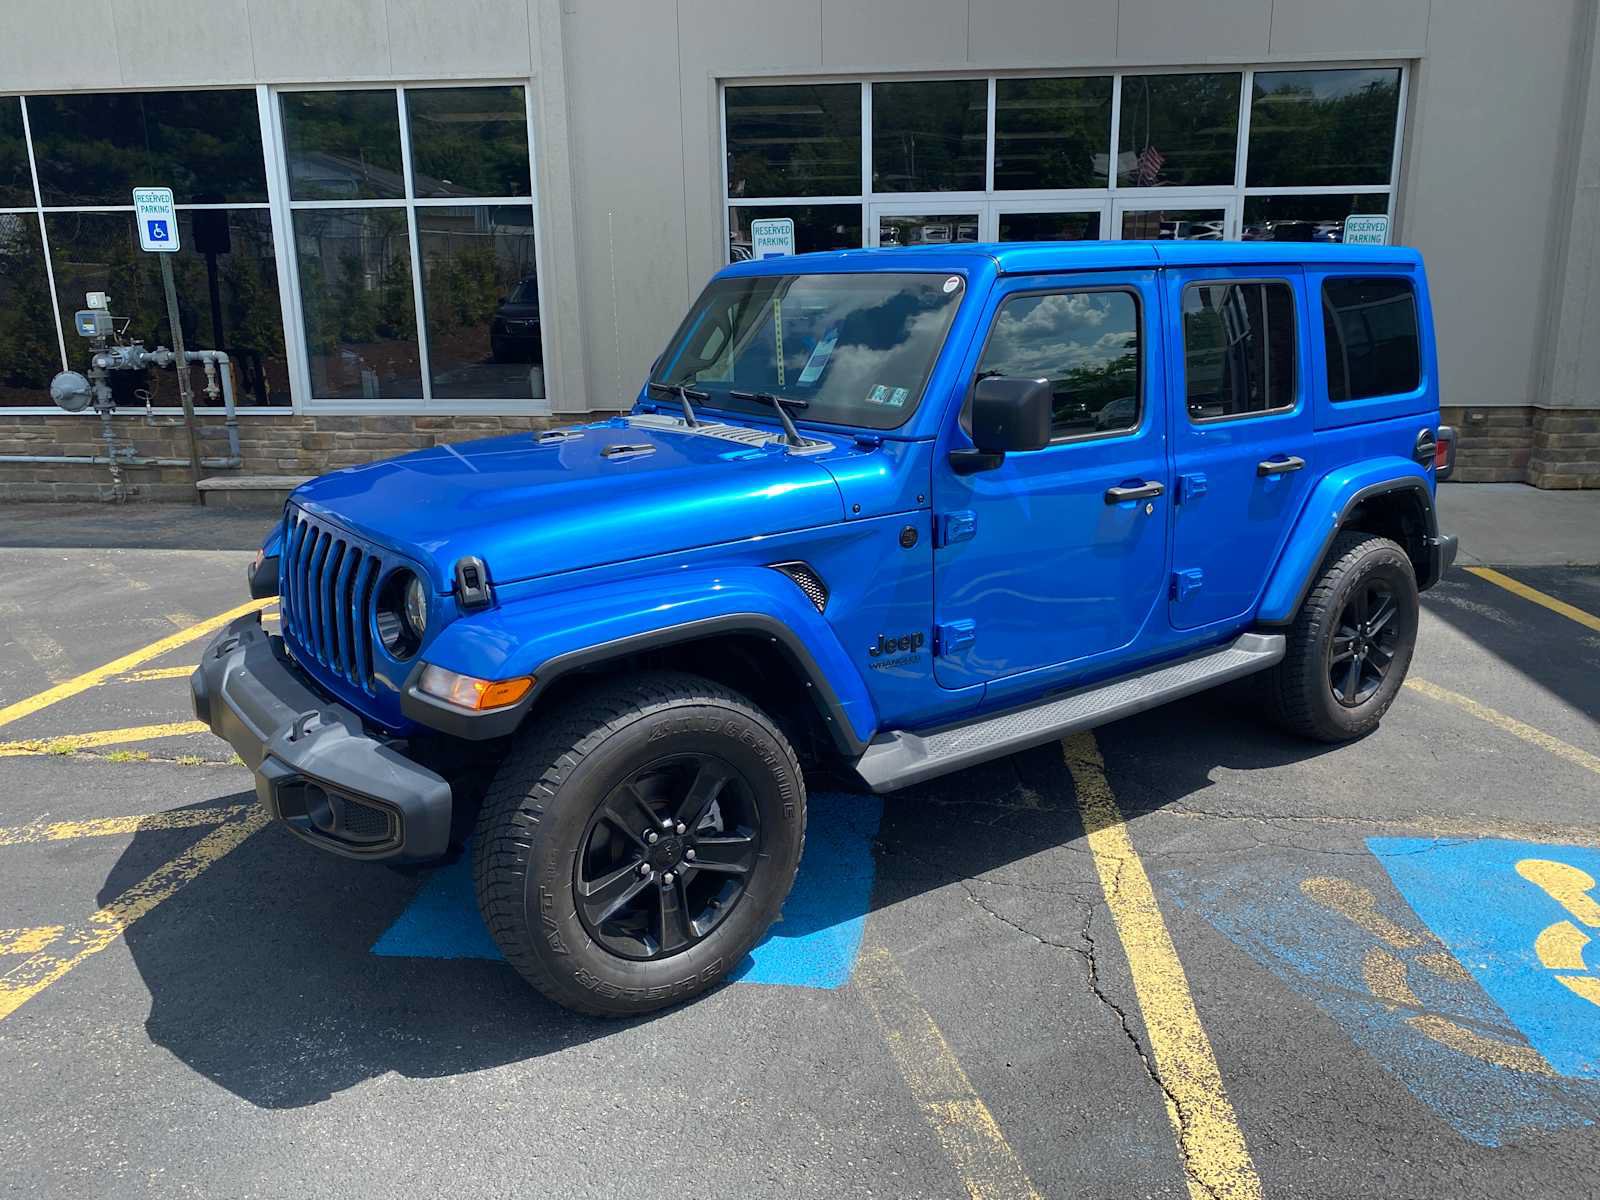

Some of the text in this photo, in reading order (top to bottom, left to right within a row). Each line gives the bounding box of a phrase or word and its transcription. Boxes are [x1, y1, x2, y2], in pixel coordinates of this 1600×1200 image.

[137, 194, 170, 203] RESERVED
[141, 205, 170, 213] PARKING
[754, 226, 791, 235] RESERVED
[1348, 222, 1386, 231] RESERVED
[758, 237, 789, 246] PARKING
[1350, 234, 1382, 243] PARKING
[869, 631, 924, 657] Jeep
